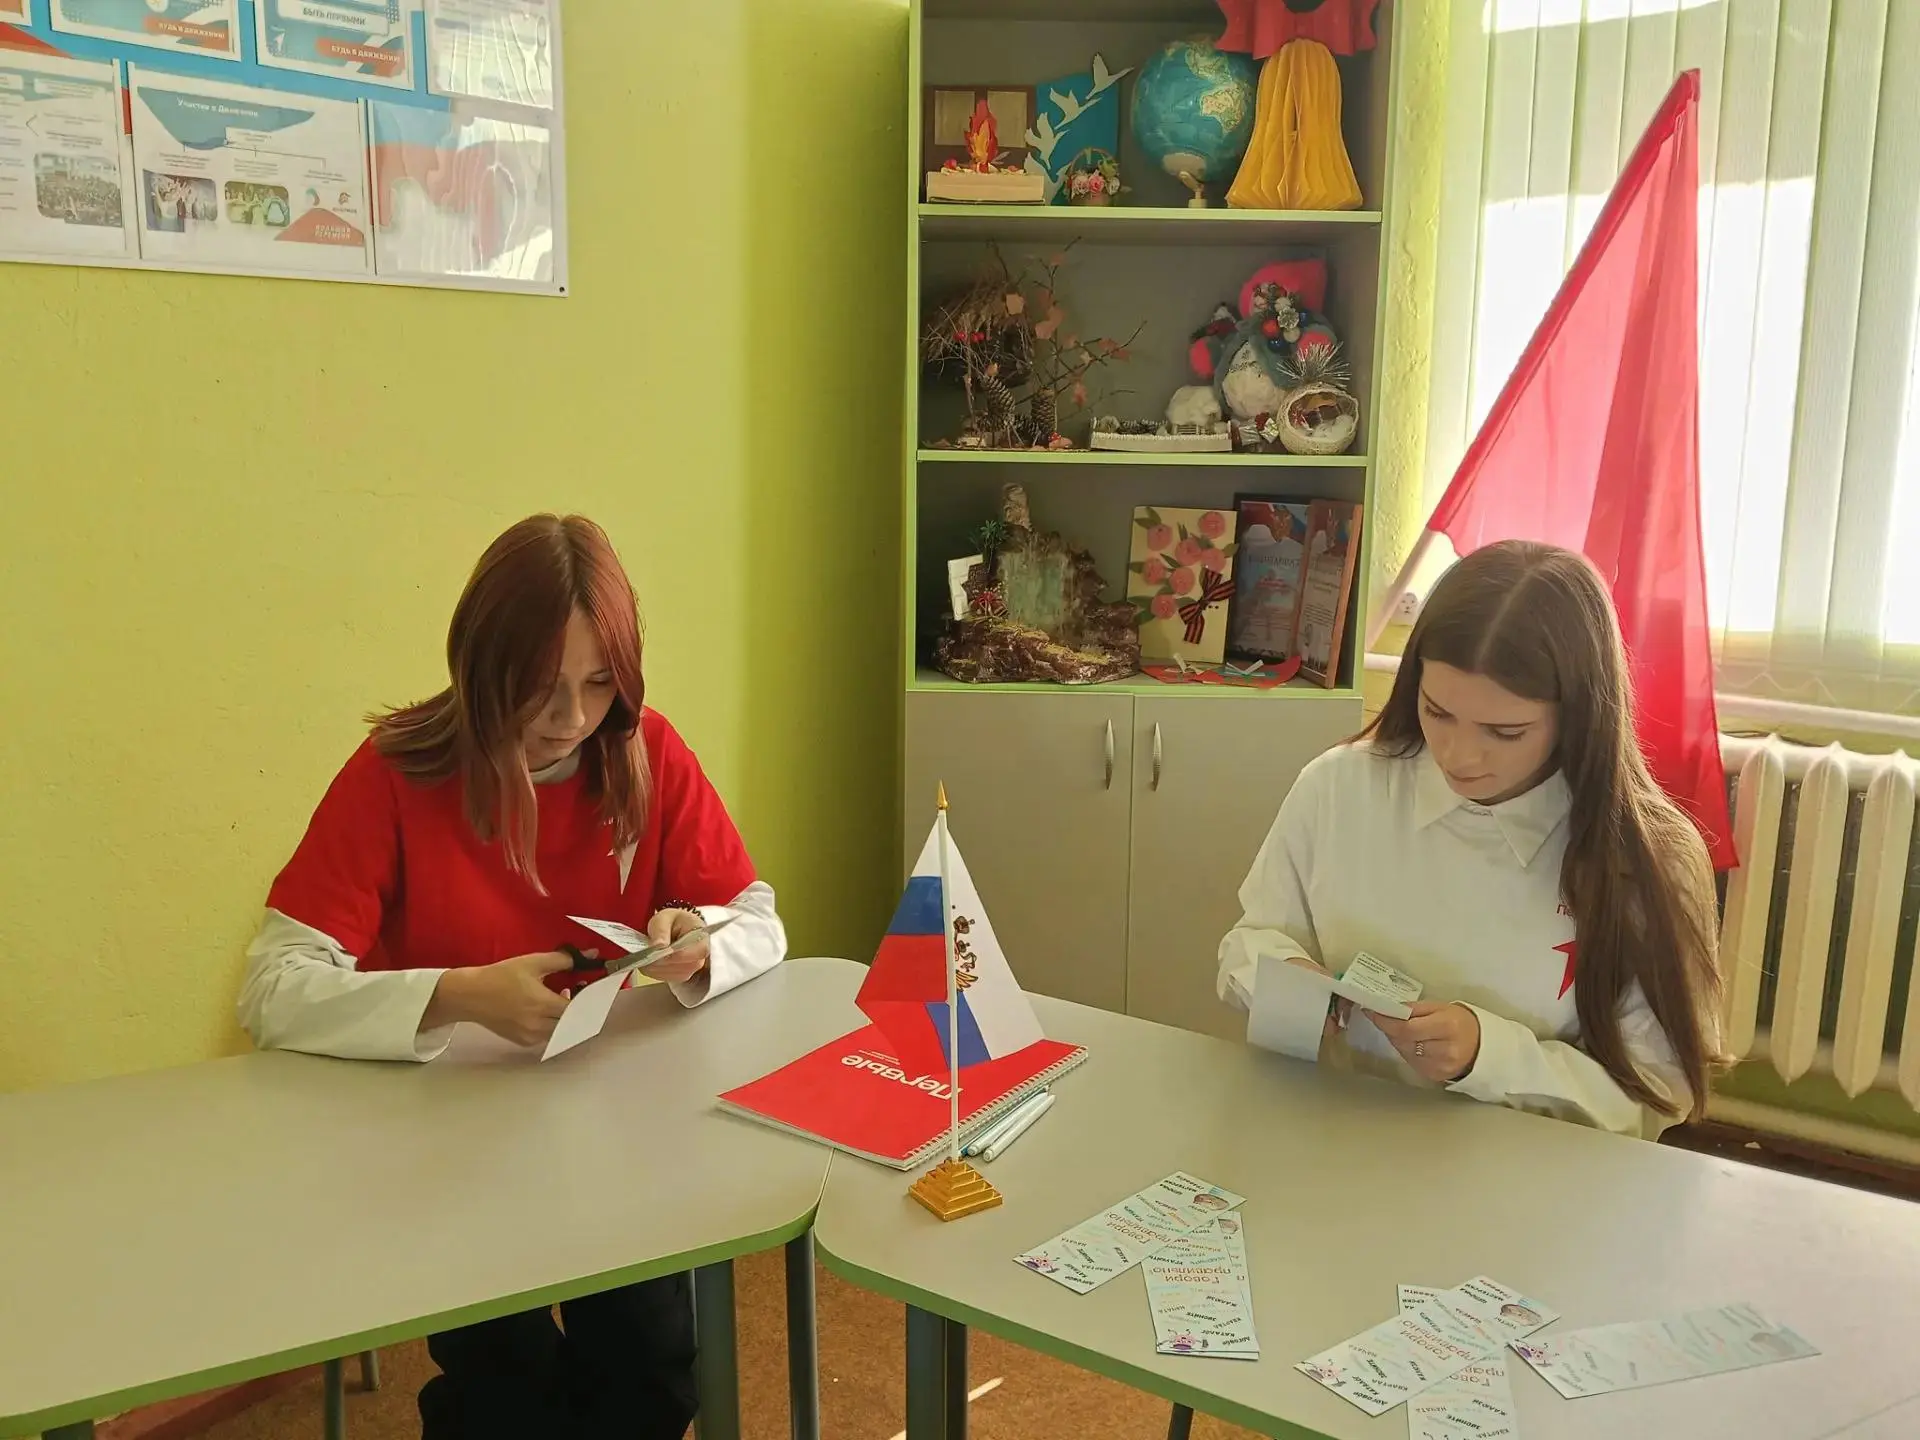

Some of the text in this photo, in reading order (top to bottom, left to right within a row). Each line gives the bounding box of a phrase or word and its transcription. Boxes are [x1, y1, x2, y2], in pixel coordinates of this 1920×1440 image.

[331, 45, 351, 55] БУДЬ
[842, 1055, 964, 1100] Первые
[1107, 1222, 1151, 1244] Говори
[1165, 1274, 1220, 1284] Говори
[1399, 1330, 1452, 1361] Говори
[1448, 1375, 1491, 1387] Гово
